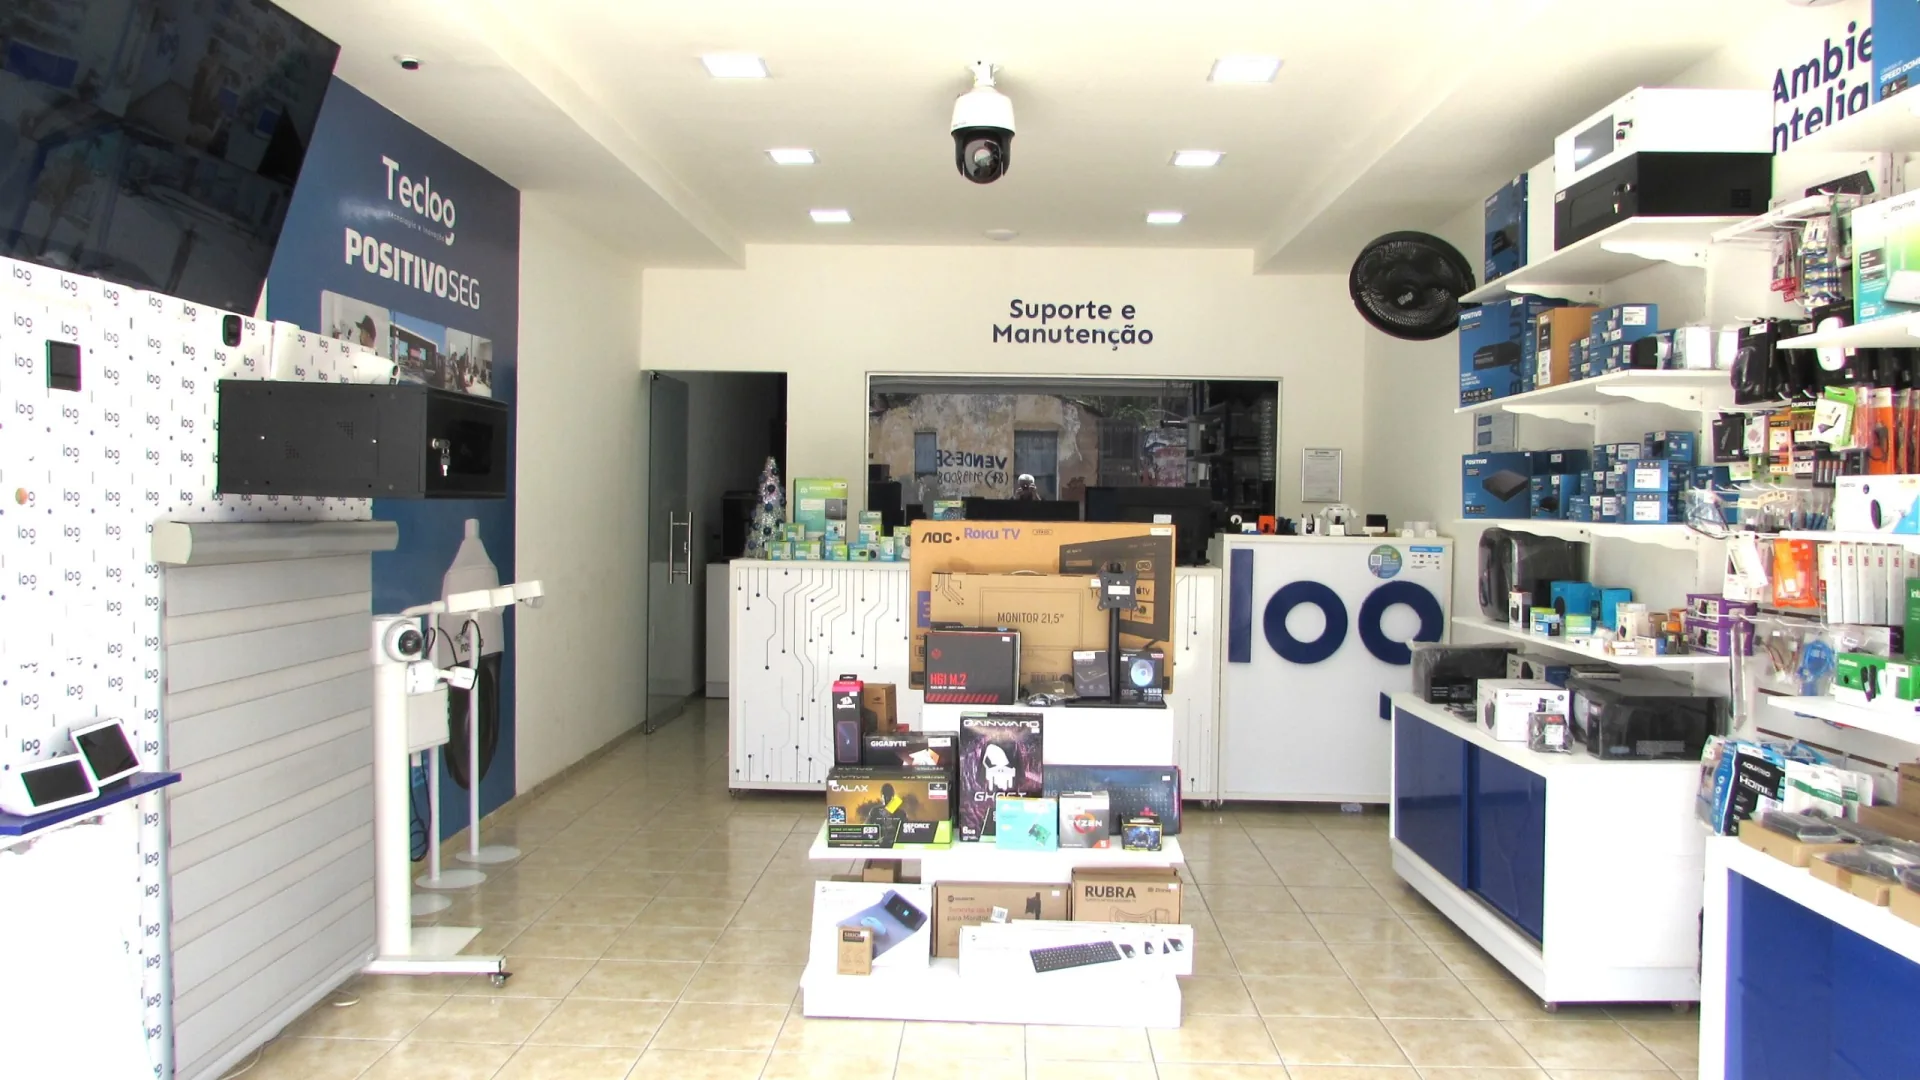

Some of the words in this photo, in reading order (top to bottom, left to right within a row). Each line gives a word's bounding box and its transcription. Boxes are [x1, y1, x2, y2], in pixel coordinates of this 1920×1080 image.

[381, 154, 456, 246] Teclog
[1009, 299, 1113, 325] Suporte
[1121, 303, 1137, 320] e
[992, 324, 1154, 351] Manutenção
[921, 532, 952, 544] AOC
[964, 527, 999, 540] Roku
[1001, 527, 1021, 540] TV
[997, 612, 1039, 624] MONITOR
[831, 784, 869, 793] GALAX
[1084, 885, 1137, 899] RUBRA
